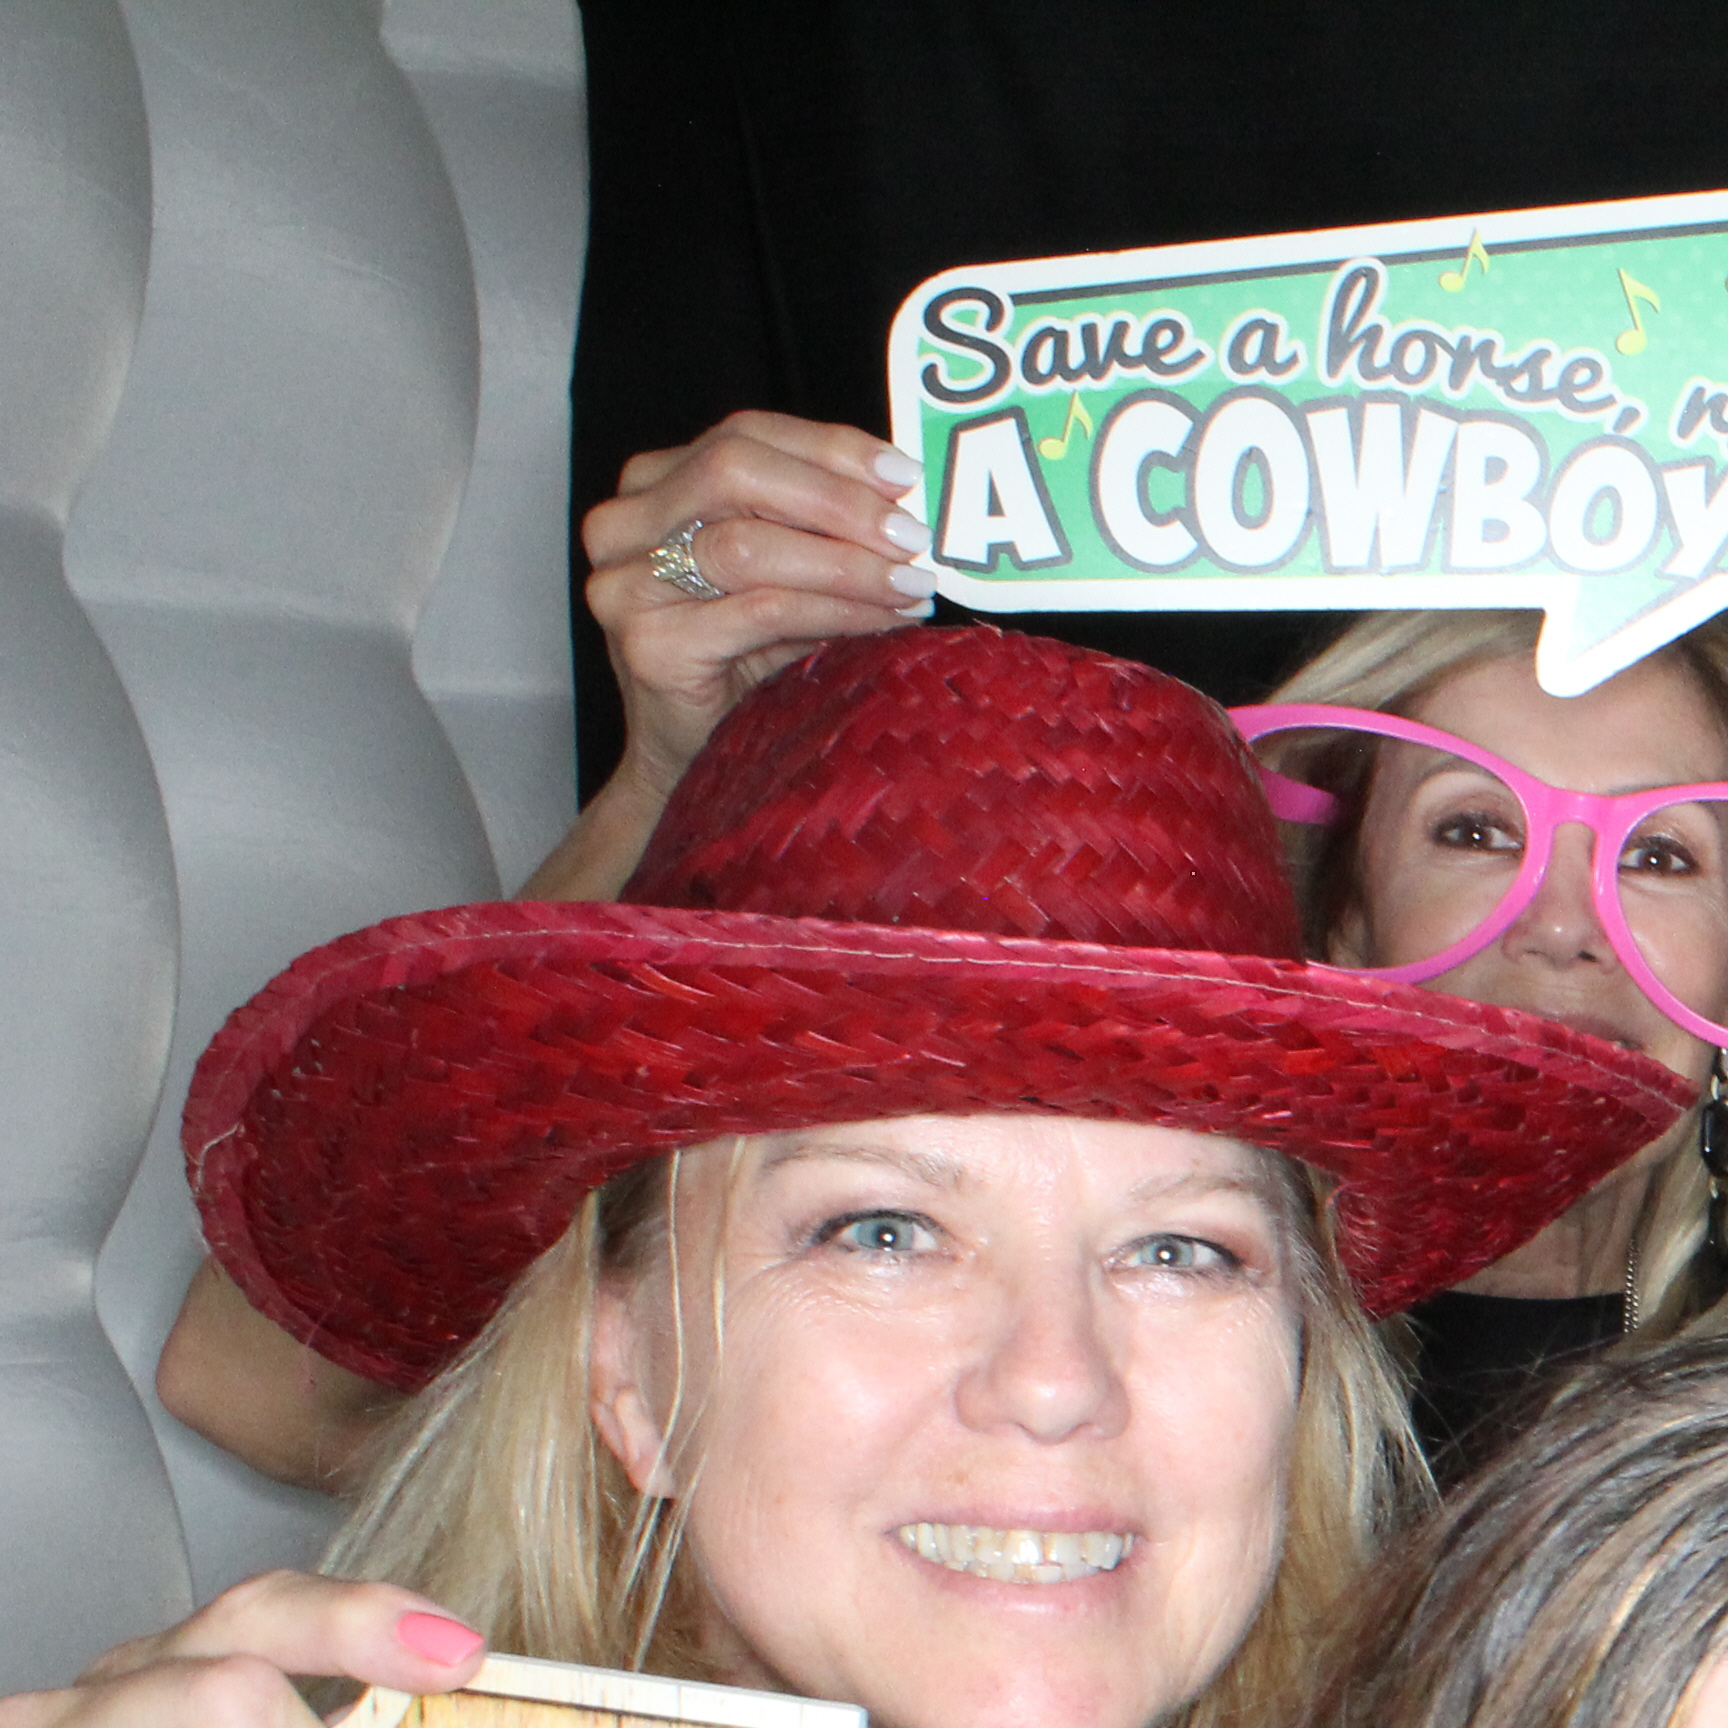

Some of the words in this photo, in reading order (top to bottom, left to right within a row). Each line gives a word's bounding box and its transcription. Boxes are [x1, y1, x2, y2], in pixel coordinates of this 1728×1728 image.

[922, 288, 1200, 402] Save
[1228, 310, 1296, 376] a
[1326, 264, 1648, 432] horse,
[940, 416, 1062, 566] A
